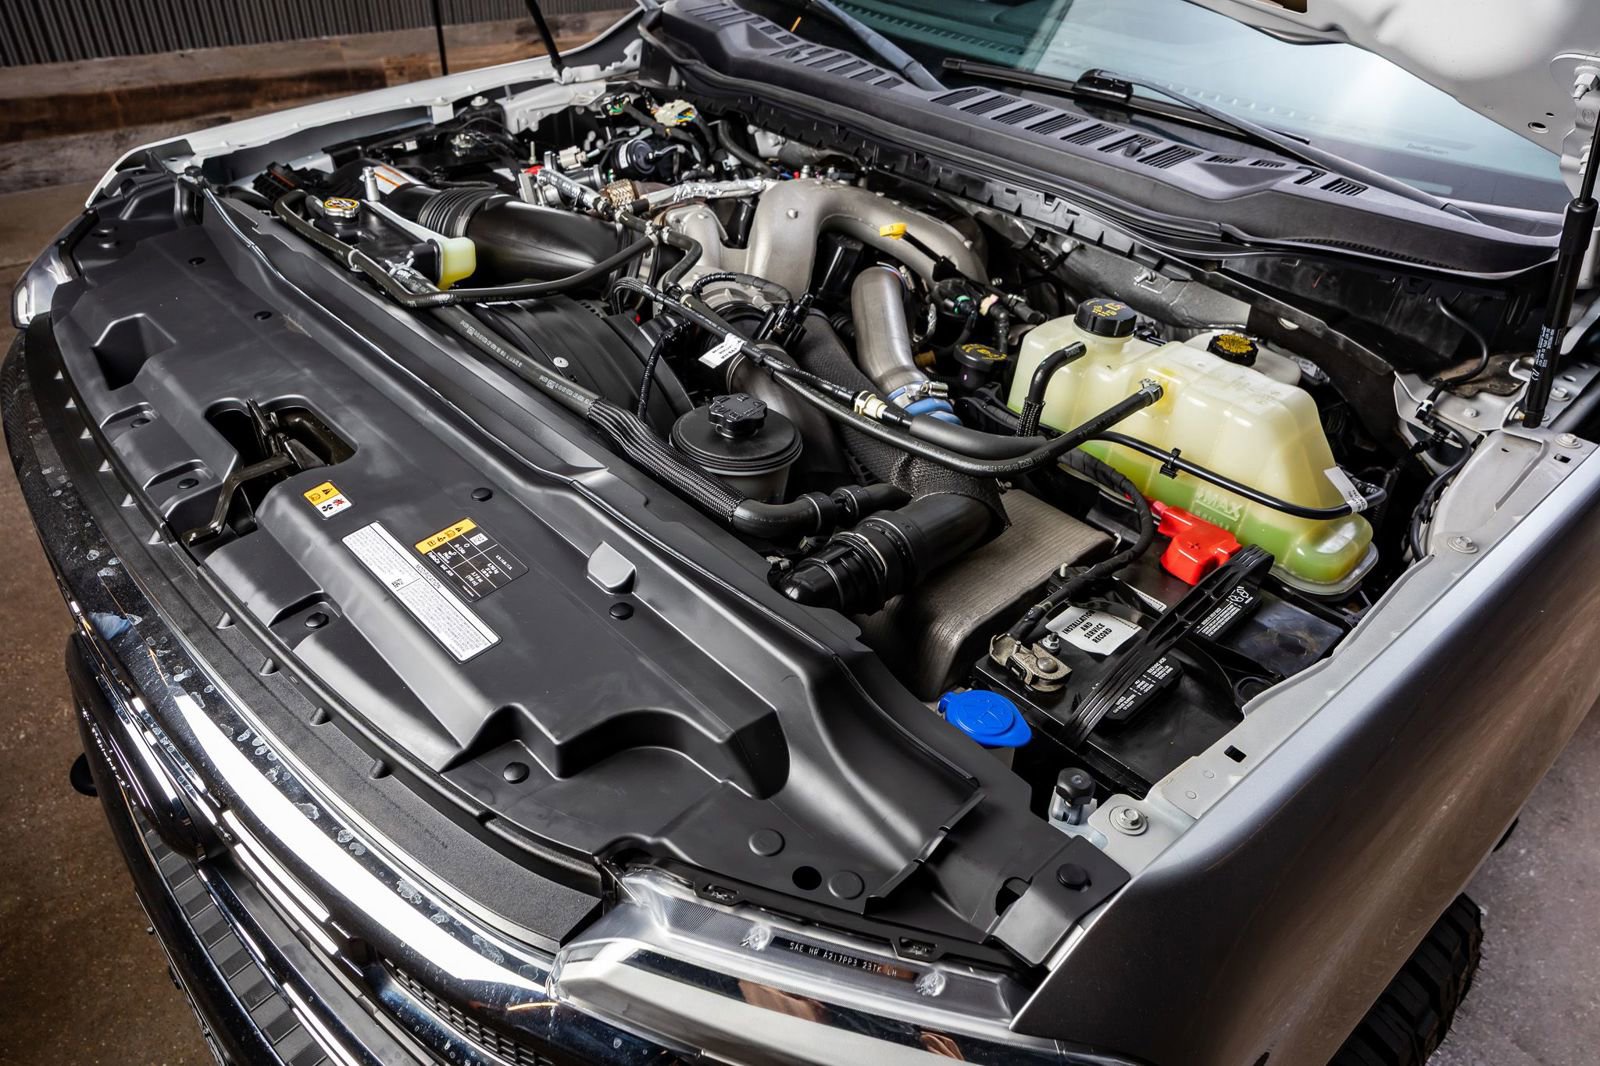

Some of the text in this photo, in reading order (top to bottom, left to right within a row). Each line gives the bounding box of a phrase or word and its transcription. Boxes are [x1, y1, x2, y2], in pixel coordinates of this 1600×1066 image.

[1062, 609, 1096, 634] INSTALLATION
[1080, 622, 1093, 632] AND
[1084, 623, 1106, 639] SERVICE
[1092, 627, 1113, 644] RECORD
[789, 942, 803, 953] SAE
[808, 947, 819, 956] HR
